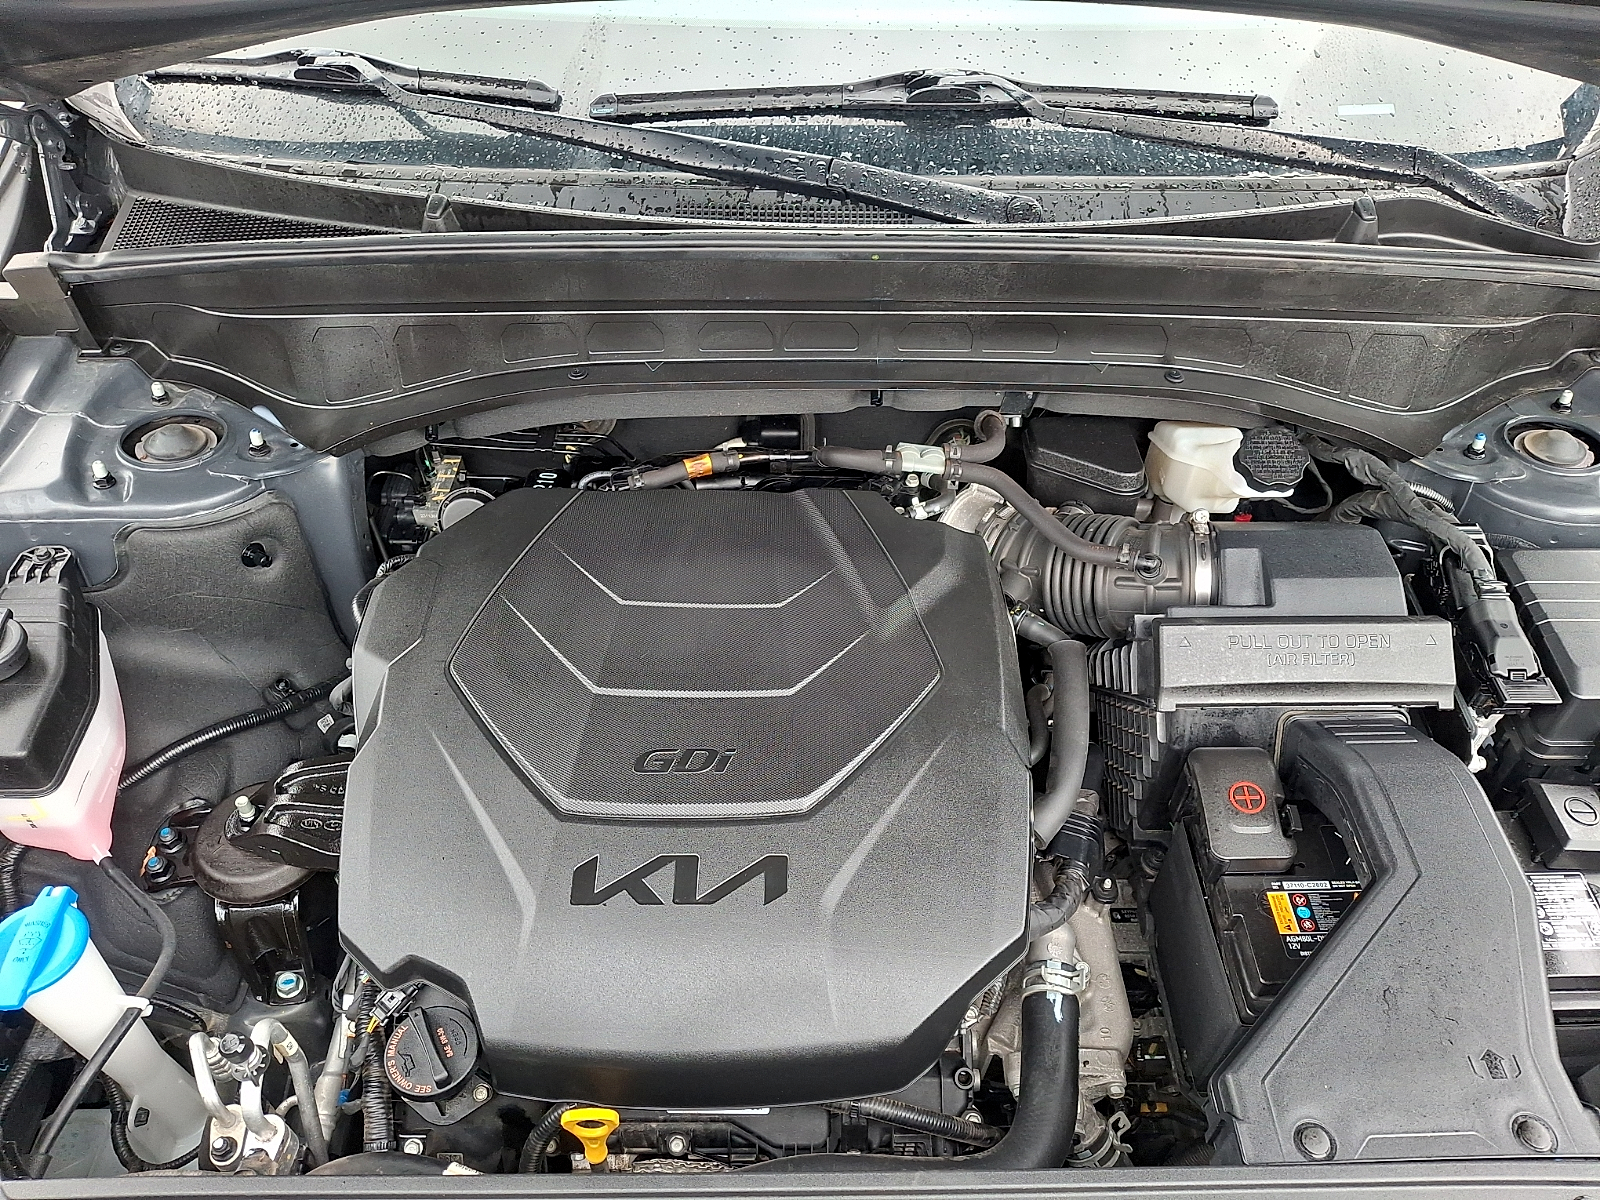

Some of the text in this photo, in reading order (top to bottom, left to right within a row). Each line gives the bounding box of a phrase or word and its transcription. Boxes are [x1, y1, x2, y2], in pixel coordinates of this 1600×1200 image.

[1228, 633, 1392, 650] PULL OUT TO OPEN
[1266, 653, 1356, 667] (AIR FILTER)
[633, 749, 737, 774] GDi
[570, 853, 789, 905] KIA
[387, 1025, 432, 1094] SEE OWNER'S MANUAL
[443, 1044, 454, 1058] SAE
